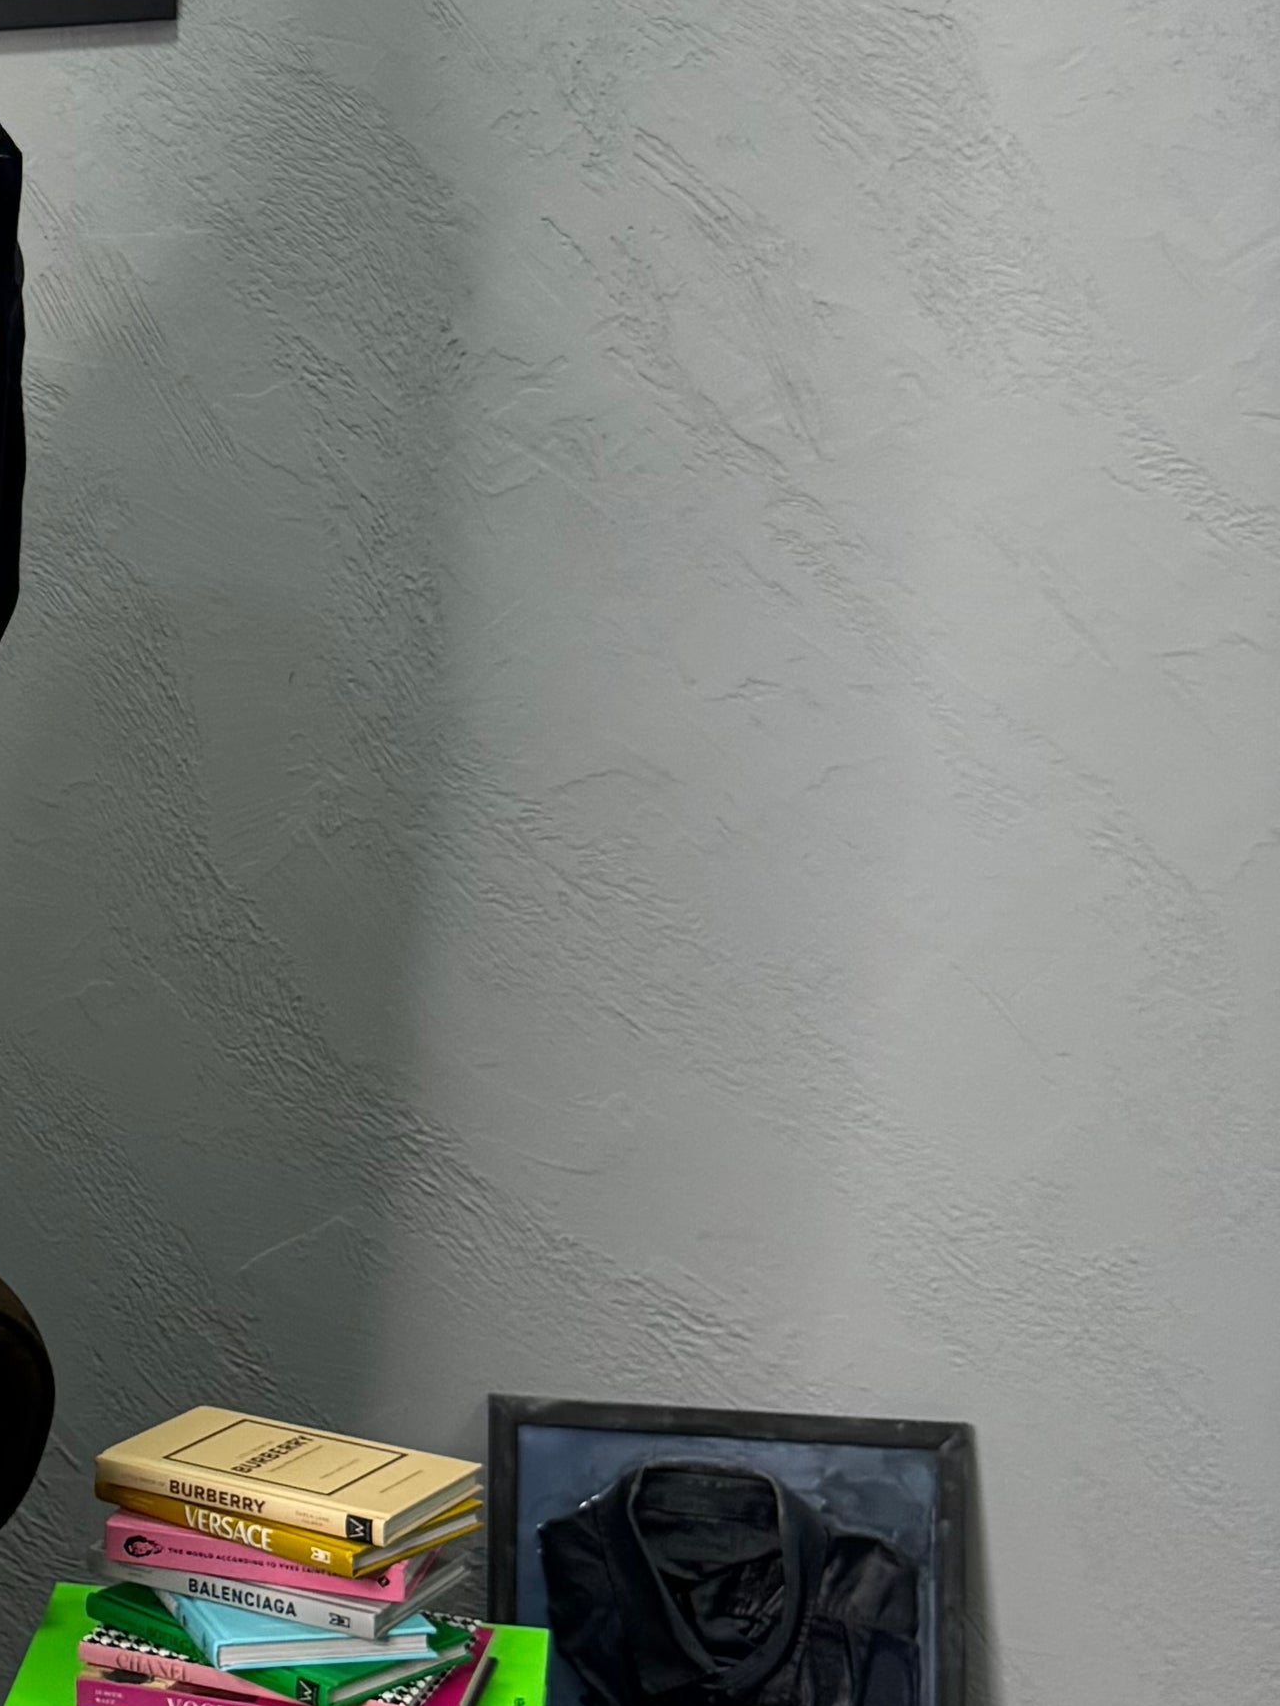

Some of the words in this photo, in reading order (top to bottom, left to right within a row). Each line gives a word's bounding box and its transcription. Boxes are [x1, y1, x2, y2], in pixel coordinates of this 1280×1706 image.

[231, 1435, 314, 1474] BURBERRY
[169, 1480, 266, 1514] BURBERRY
[184, 1505, 274, 1553] VERSACE
[168, 1547, 183, 1555] THE
[186, 1550, 214, 1560] WORLD
[216, 1554, 264, 1566] ACCORDING
[279, 1564, 300, 1573] YVES
[189, 1578, 298, 1617] BALENCIAGA
[116, 1651, 189, 1682] CHANEL
